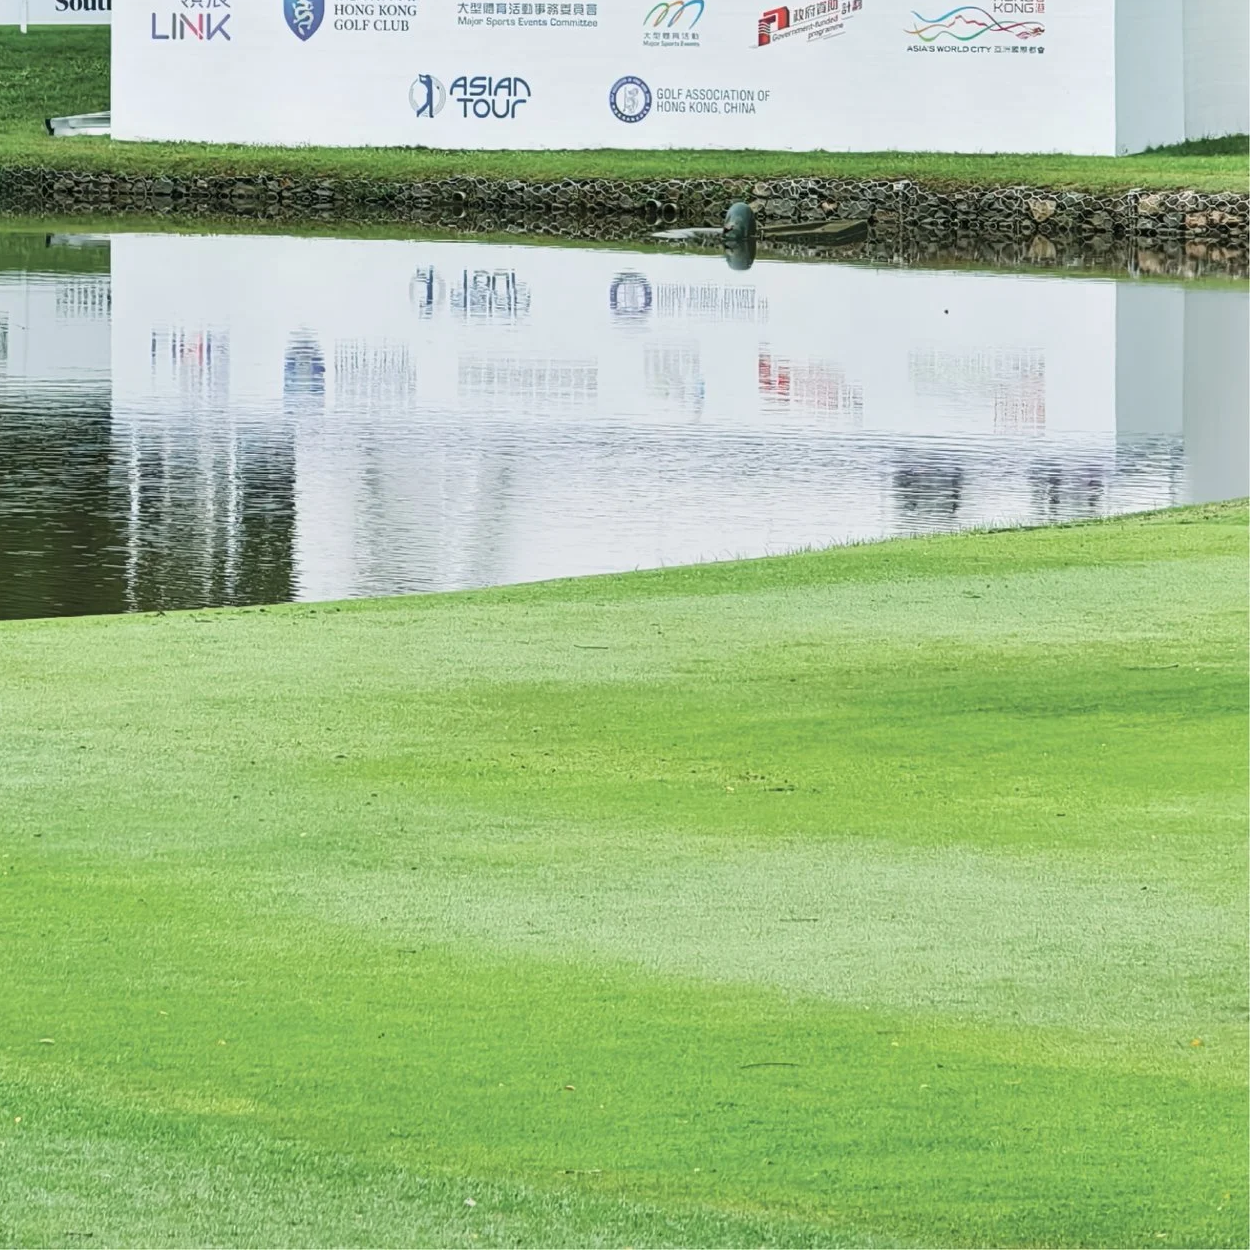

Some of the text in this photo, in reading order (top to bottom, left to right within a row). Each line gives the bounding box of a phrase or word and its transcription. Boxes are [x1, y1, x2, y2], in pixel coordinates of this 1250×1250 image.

[334, 4, 417, 16] HONG KONG
[993, 3, 1035, 14] KONG
[152, 12, 231, 41] LINK
[334, 19, 409, 31] GOLF CLUB
[458, 16, 598, 27] Major Sports Events Committee
[808, 23, 844, 39] programme
[450, 76, 531, 97] ASIAN
[656, 88, 770, 101] GOLF ASSOCIATION OF
[457, 98, 527, 118] TOUR
[656, 101, 756, 114] HONG KONG, CHINA
